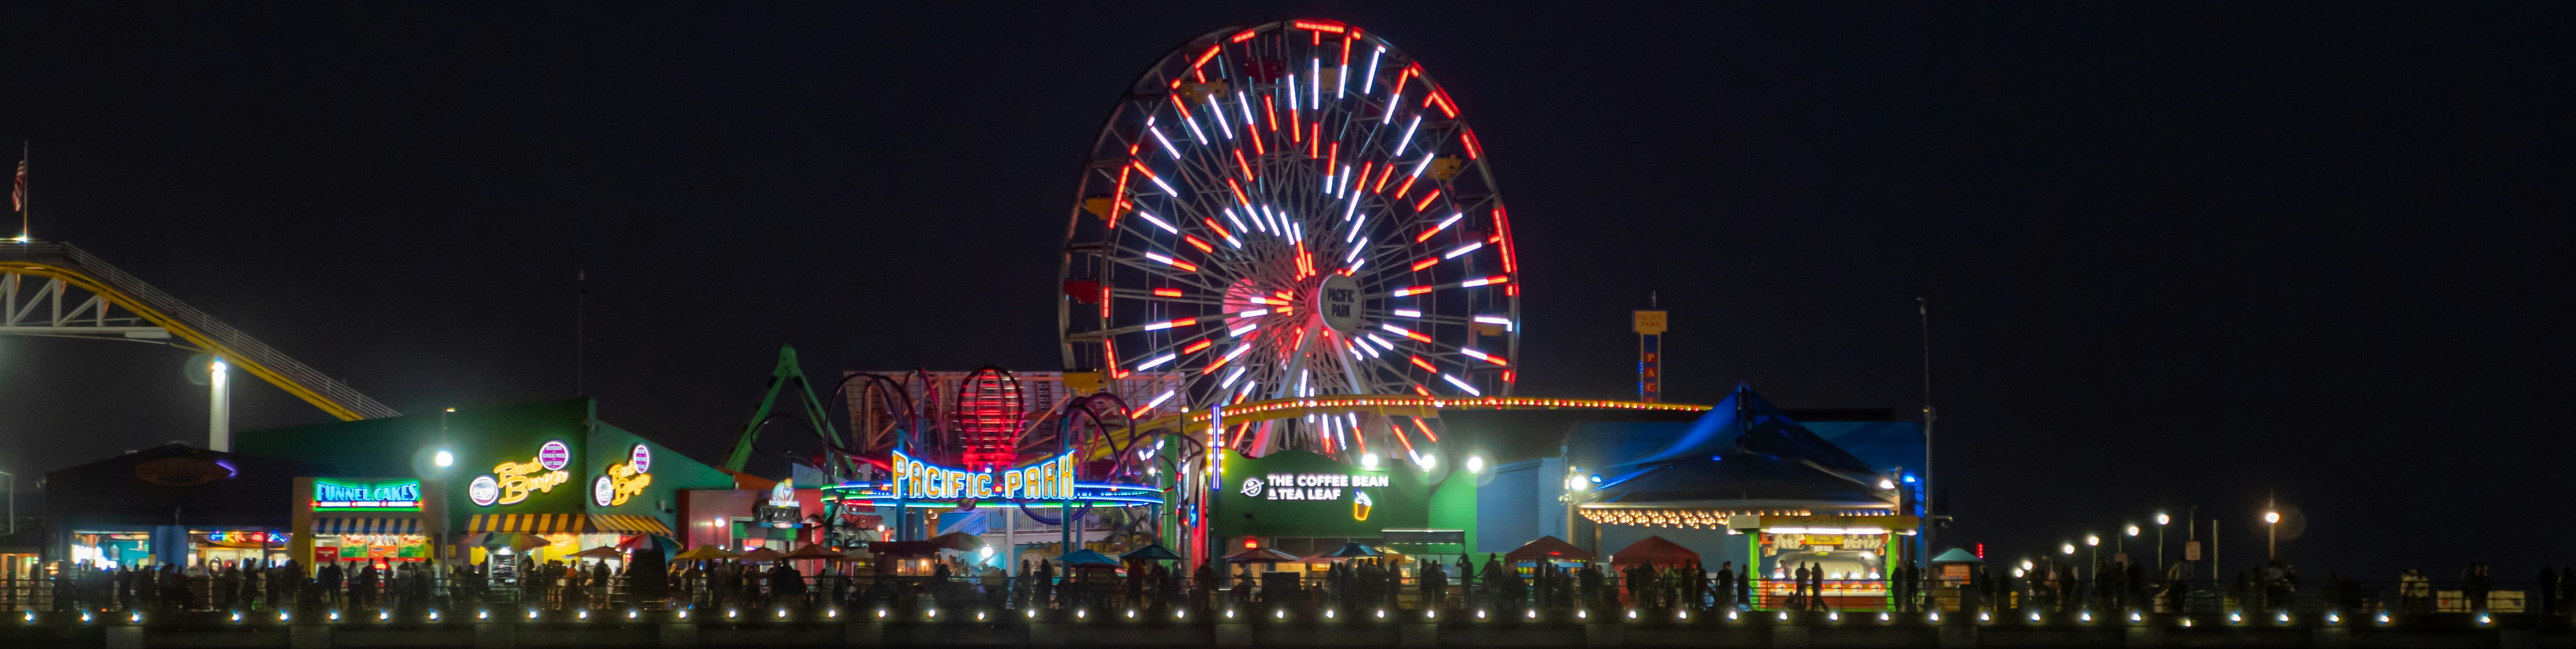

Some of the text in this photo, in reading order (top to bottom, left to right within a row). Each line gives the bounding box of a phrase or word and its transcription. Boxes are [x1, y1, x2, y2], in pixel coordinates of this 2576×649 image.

[1327, 288, 1355, 303] PACIFIC
[1331, 304, 1350, 318] PARK
[493, 457, 543, 488] Beach
[892, 449, 1076, 500] PACIFIC PARK
[1267, 474, 1389, 487] THE COFFEE BEAN
[317, 483, 418, 501] FUNNEL CAKES
[498, 470, 568, 504] Burger
[1308, 488, 1341, 500] LEAF
